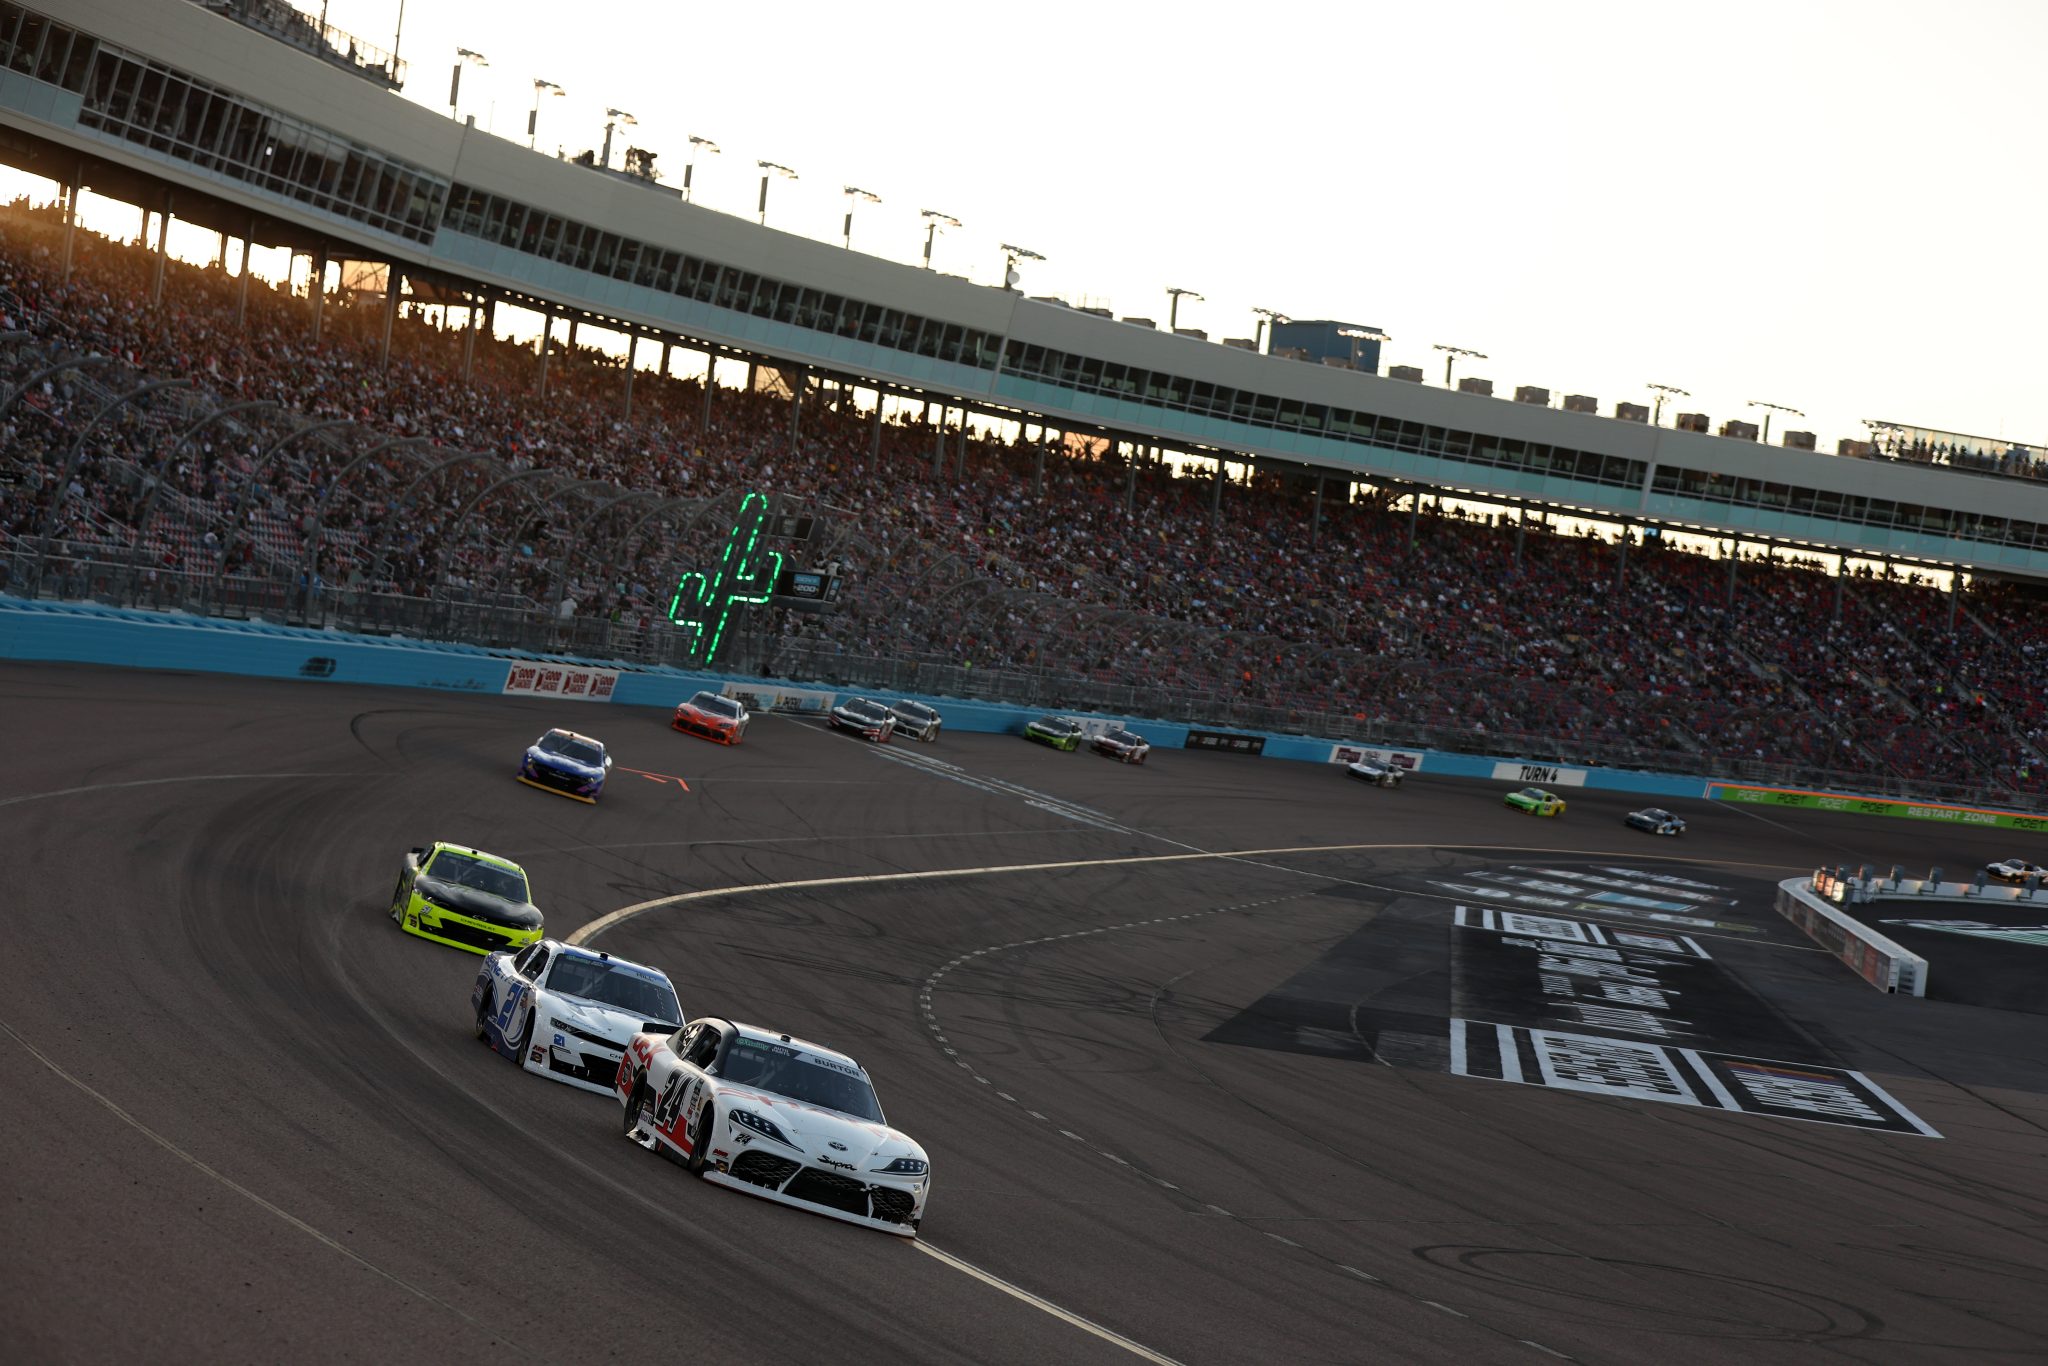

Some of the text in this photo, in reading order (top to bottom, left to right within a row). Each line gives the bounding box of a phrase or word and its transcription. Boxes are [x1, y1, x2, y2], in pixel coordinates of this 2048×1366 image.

[1519, 765, 1558, 783] TURN 4
[1737, 789, 1767, 802] POET
[1776, 793, 1808, 805] POET
[1817, 798, 1849, 810] POET
[1860, 802, 1892, 814] POET
[1908, 807, 1997, 824] RESTART ZONE
[2013, 817, 2045, 829] POET
[814, 1058, 860, 1078] BURTON
[654, 1067, 698, 1134] 24
[735, 1132, 753, 1145] 24
[816, 1154, 858, 1171] Supra
